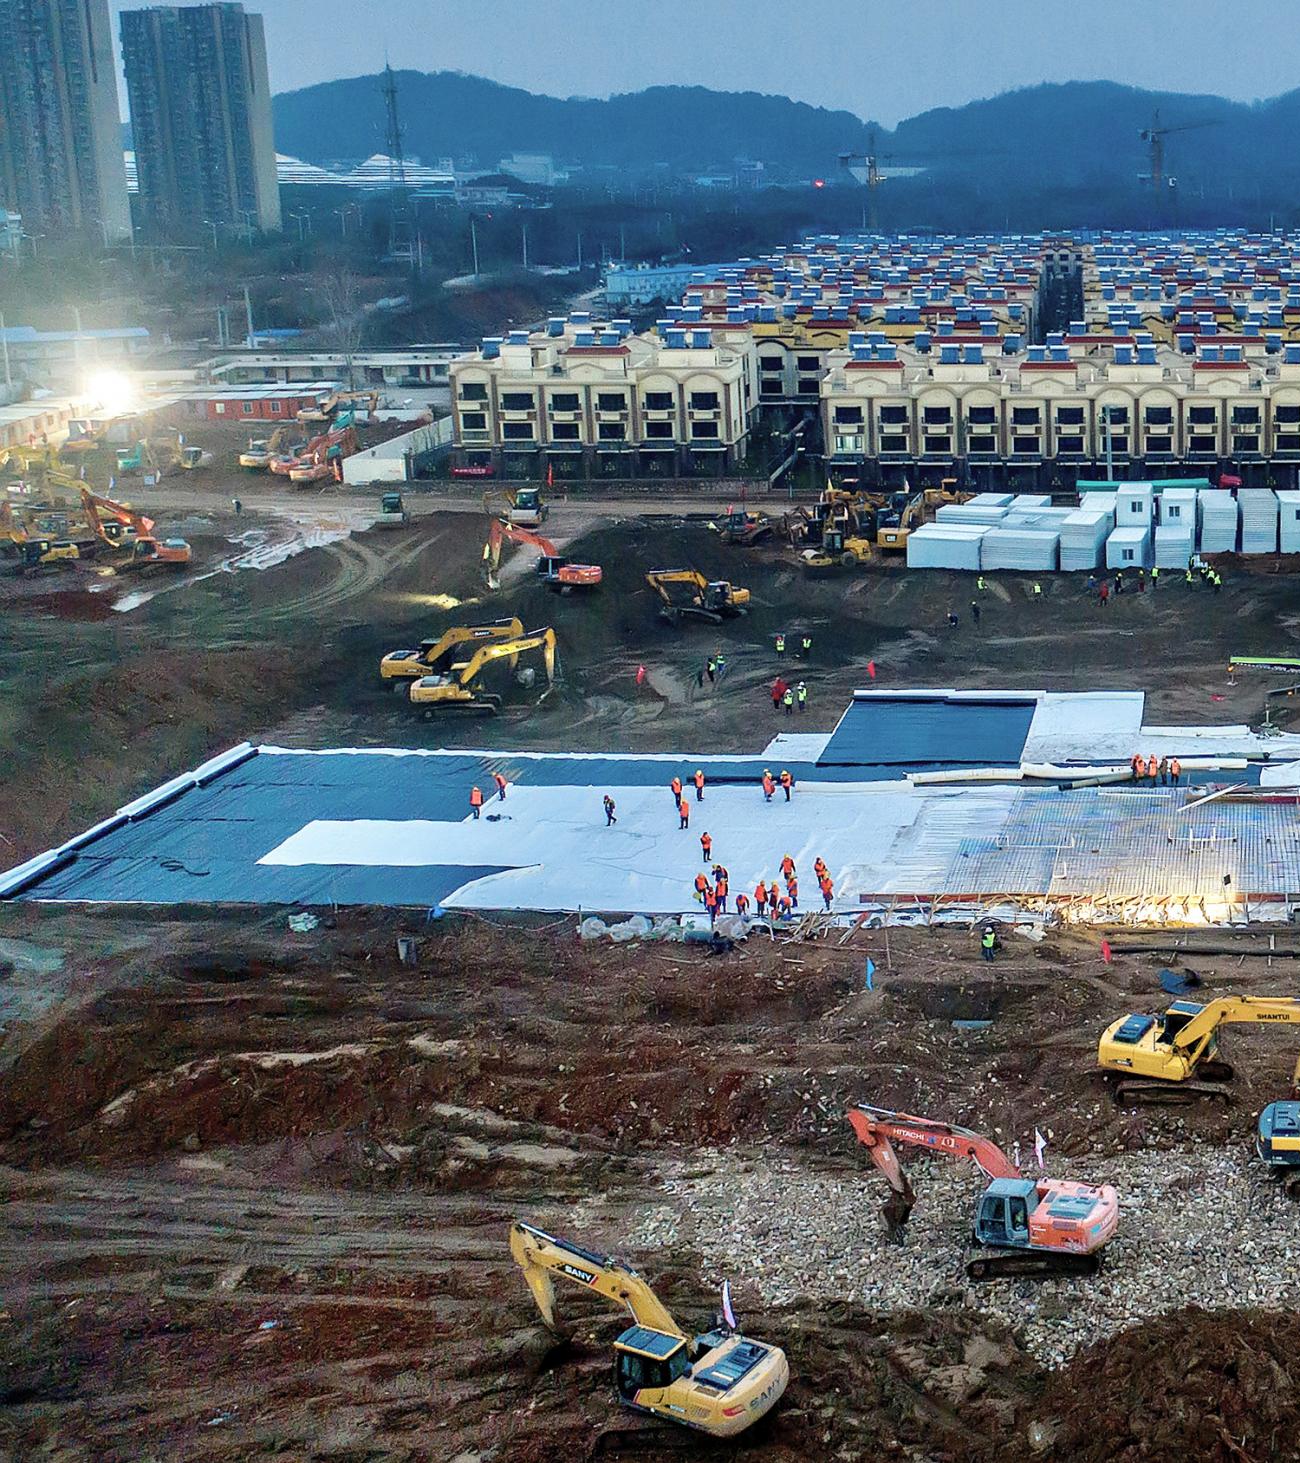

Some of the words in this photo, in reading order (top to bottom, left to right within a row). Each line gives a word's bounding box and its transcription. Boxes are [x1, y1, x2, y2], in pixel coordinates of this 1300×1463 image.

[1256, 1013, 1290, 1021] SHANTUI
[893, 1128, 925, 1141] HITACHI
[564, 1264, 592, 1282] SANY
